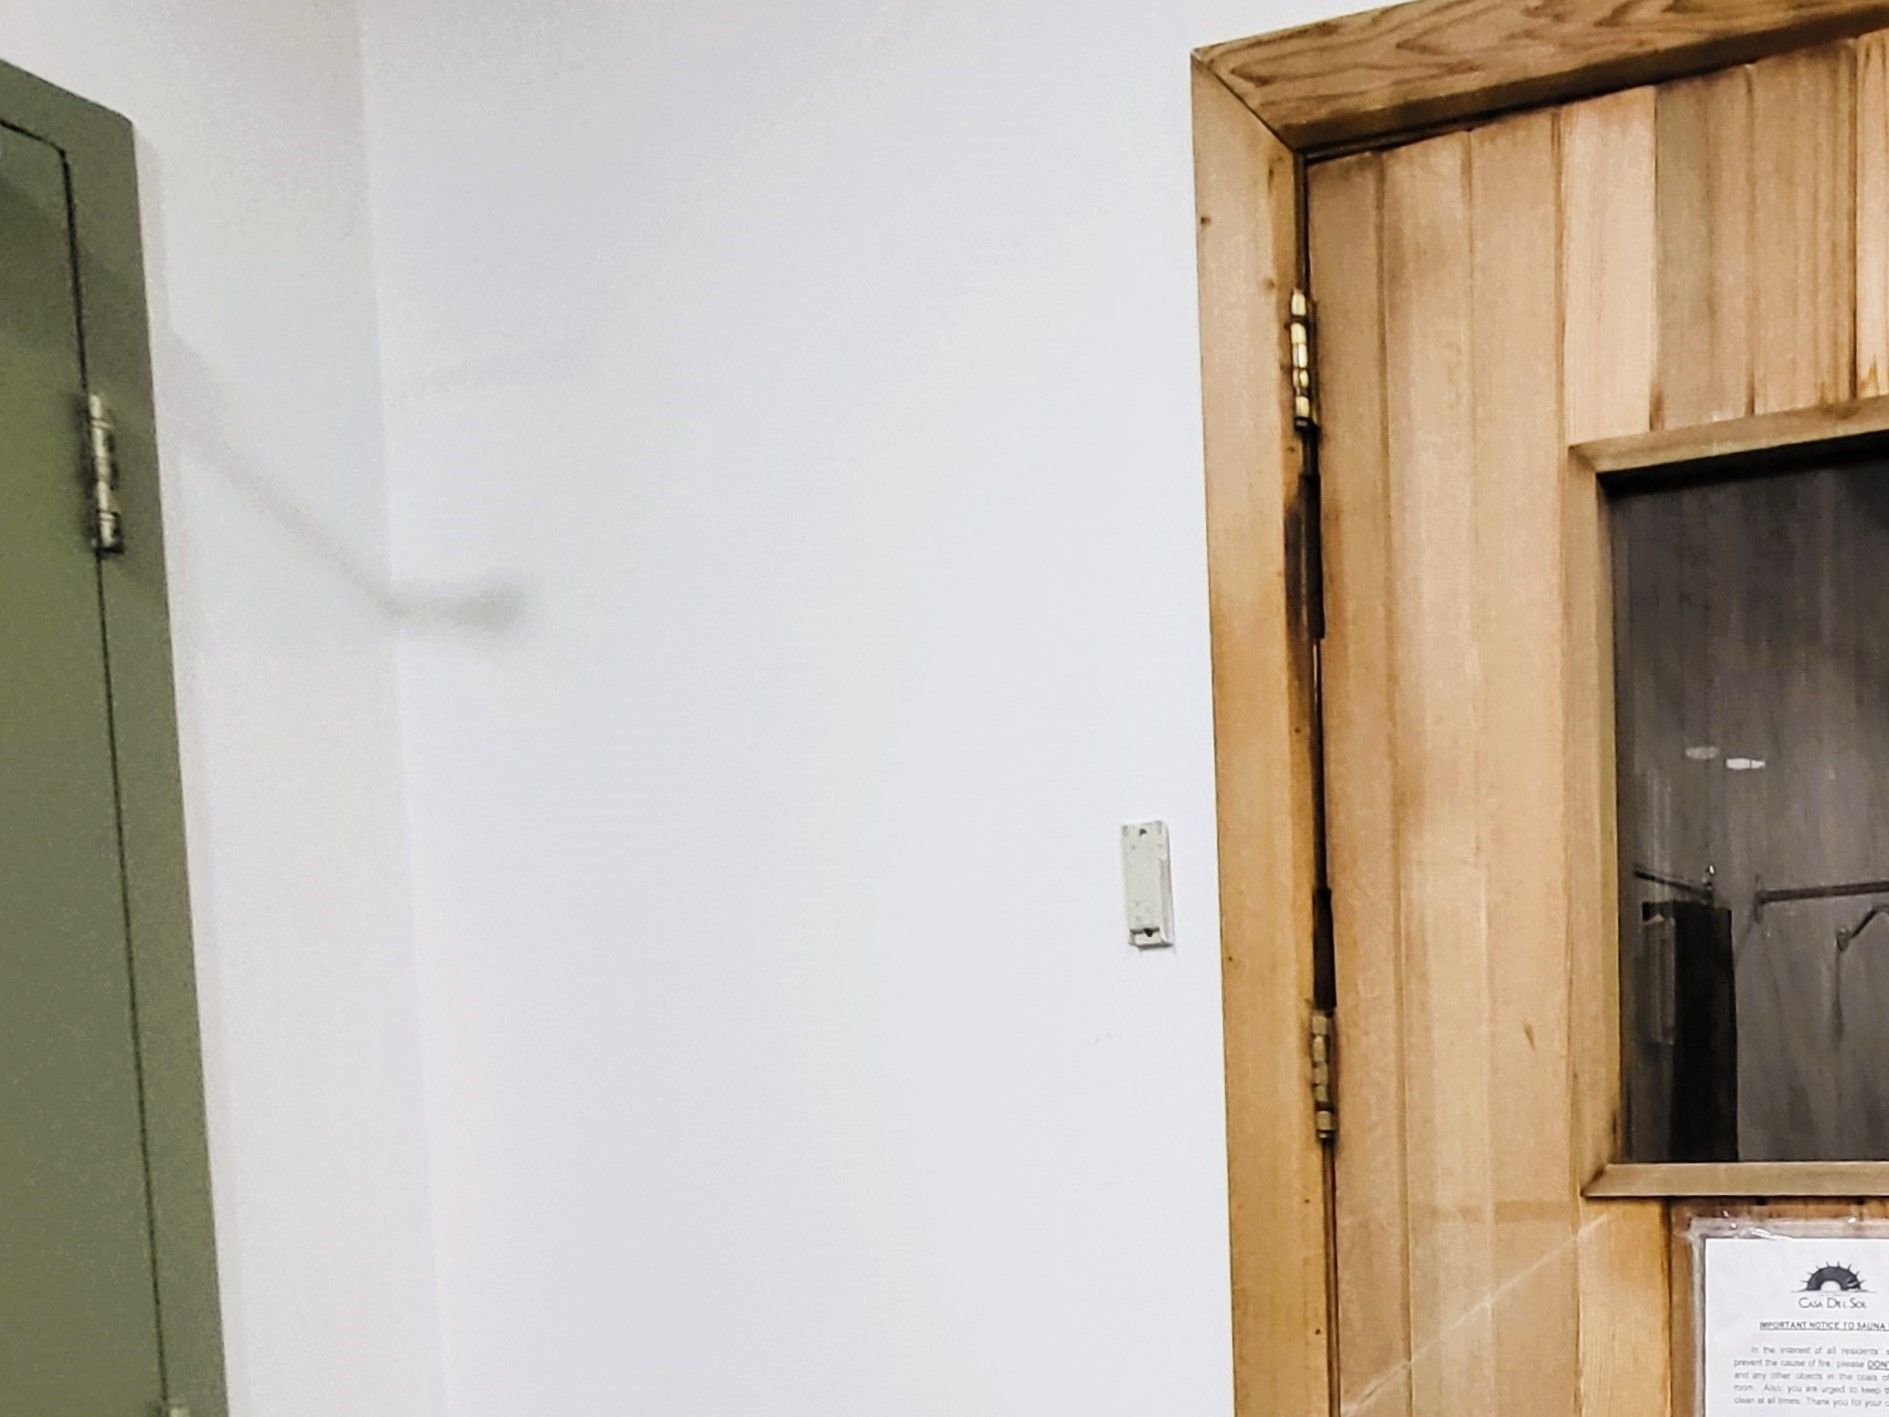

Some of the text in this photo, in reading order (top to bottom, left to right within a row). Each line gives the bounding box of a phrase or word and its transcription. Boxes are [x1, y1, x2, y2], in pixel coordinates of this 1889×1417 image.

[1759, 1321, 1806, 1331] IMPORTANT
[1808, 1321, 1839, 1331] NOTICE
[1843, 1322, 1855, 1332] TO
[1857, 1322, 1886, 1332] SAUNA
[1814, 1346, 1823, 1355] of
